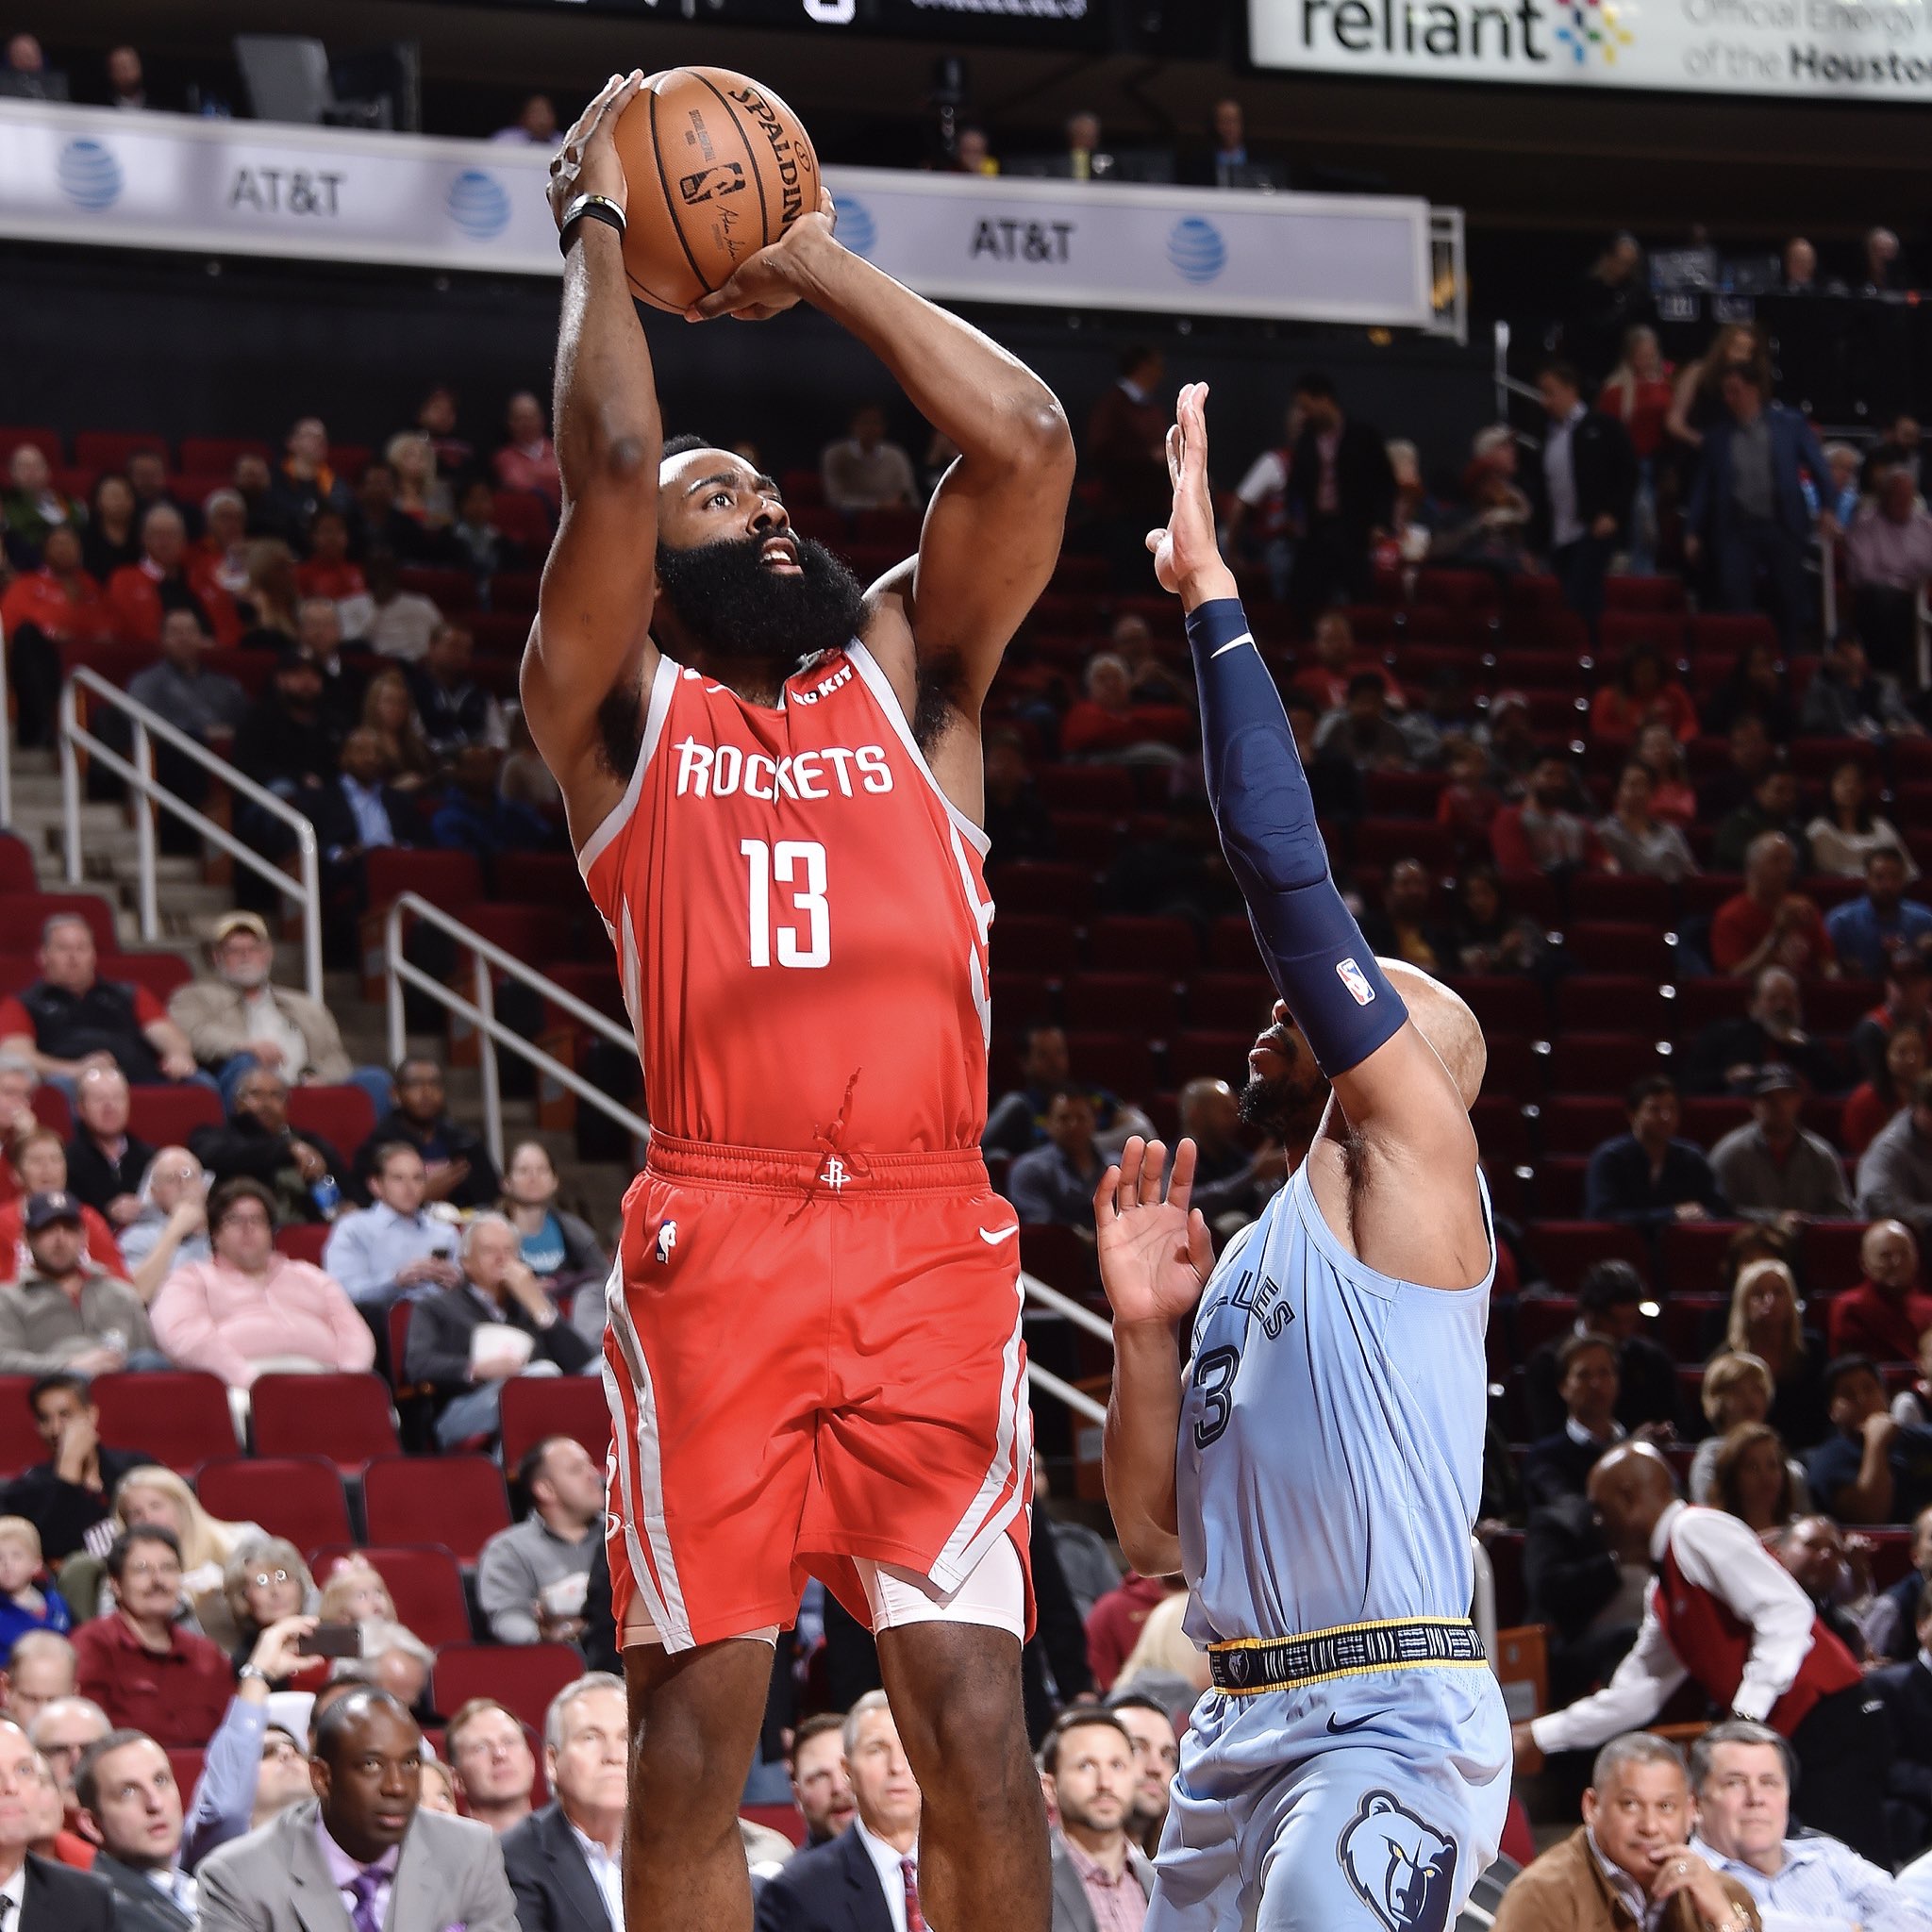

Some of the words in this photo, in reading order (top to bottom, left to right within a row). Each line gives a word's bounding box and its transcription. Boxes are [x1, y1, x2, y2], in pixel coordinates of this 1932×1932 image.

[1302, 0, 1547, 61] reliant
[1789, 42, 1932, 83] Housto
[227, 167, 347, 217] AT&T
[968, 217, 1077, 264] AT&T
[674, 734, 895, 804] ROCKETS
[740, 838, 832, 969] 13
[1192, 1343, 1241, 1451] 3
